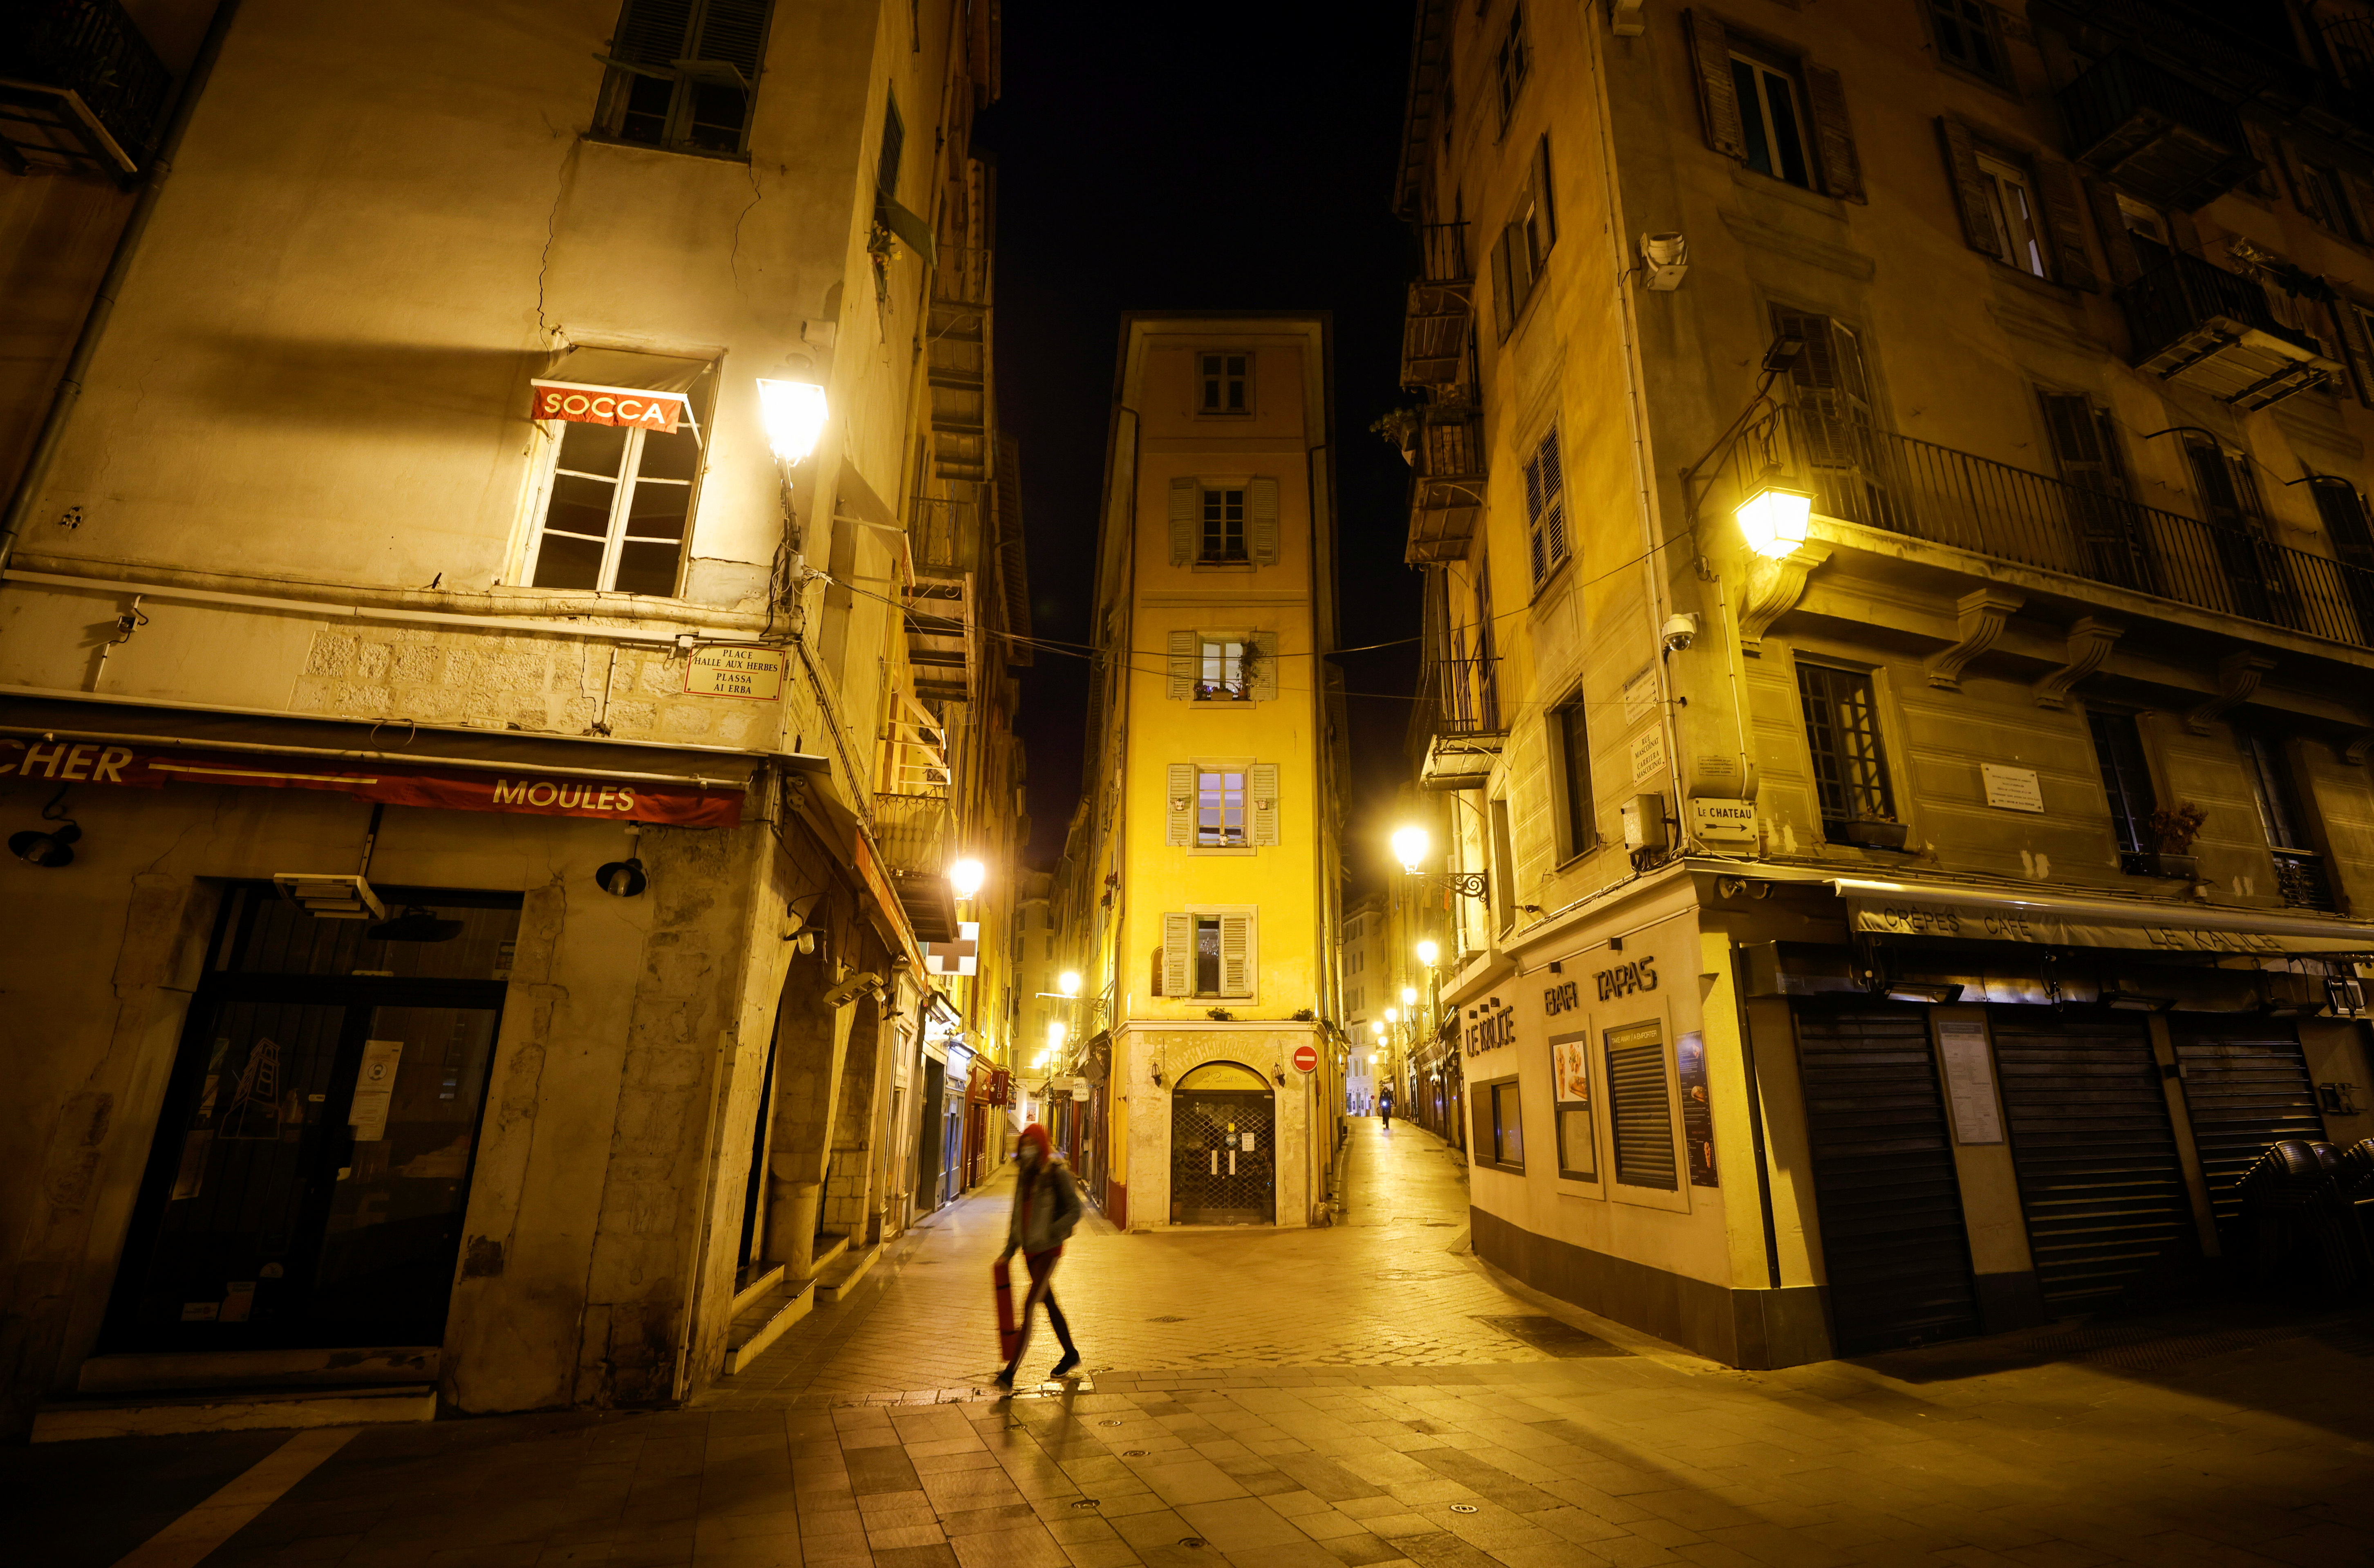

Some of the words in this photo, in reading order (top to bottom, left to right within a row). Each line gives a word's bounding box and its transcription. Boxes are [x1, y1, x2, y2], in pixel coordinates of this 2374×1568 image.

[544, 393, 665, 424] SOCCA
[723, 650, 753, 659] PLACE
[694, 657, 721, 667] HALLE
[725, 660, 743, 669] AUX
[746, 662, 778, 672] HERBES
[716, 673, 752, 683] PLASSA
[713, 683, 724, 692] AI
[728, 684, 751, 694] ERBA
[1642, 734, 1650, 746] RUE
[1637, 750, 1660, 770] CARRIERA
[493, 779, 635, 812] MOULES
[1710, 808, 1751, 819] CHATEAU
[1884, 907, 1960, 932] CRÊPES
[1984, 914, 2032, 941] CAFÉ
[2141, 925, 2184, 947] LE
[1544, 981, 1578, 1016] BAR
[1592, 956, 1657, 1002] TAPAS
[1466, 1025, 1480, 1058] LE
[1637, 1030, 1657, 1039] EMPORTER
